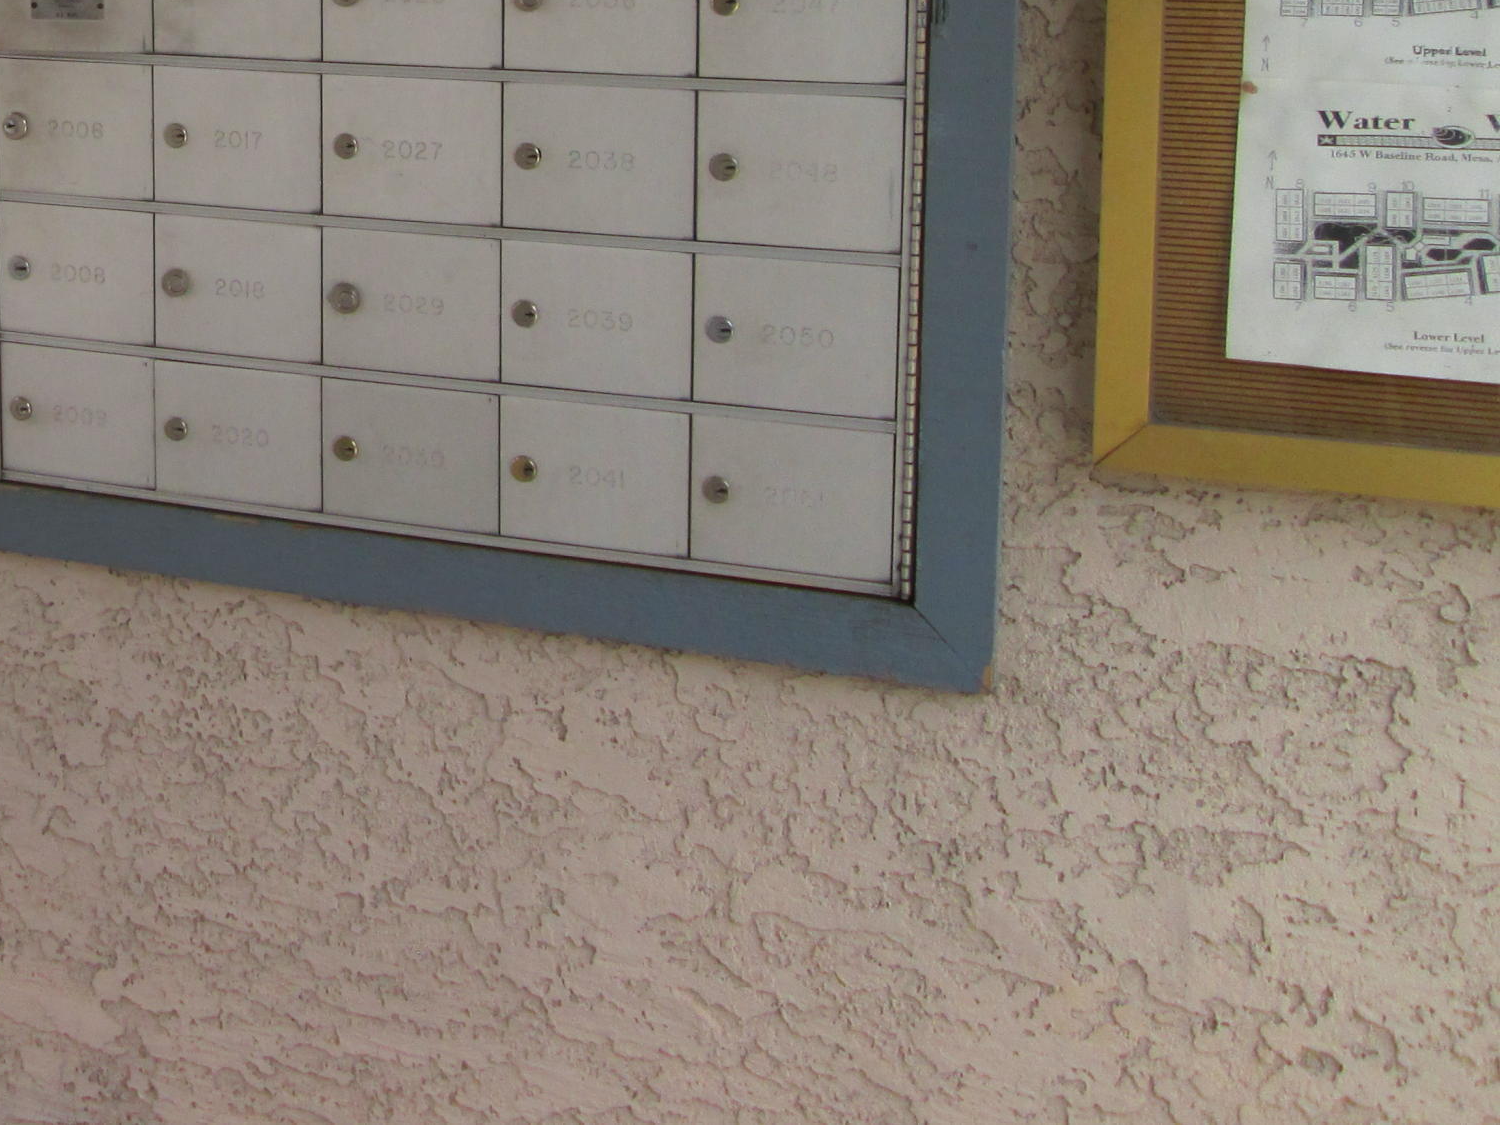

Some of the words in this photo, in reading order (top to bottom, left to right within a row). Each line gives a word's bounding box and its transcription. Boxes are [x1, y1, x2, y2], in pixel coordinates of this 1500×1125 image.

[1354, 18, 1364, 28] 6
[1392, 18, 1401, 28] 5
[1412, 45, 1451, 58] Upper
[1455, 46, 1487, 57] Level
[1317, 110, 1416, 131] Water
[214, 130, 262, 150] 2017
[382, 140, 442, 160] 2027
[568, 150, 635, 171] 2038
[1330, 150, 1357, 159] 1645
[1360, 150, 1371, 159] W
[1375, 151, 1422, 162] Baseline
[1425, 152, 1458, 163] Road,
[1402, 180, 1415, 191] 10
[215, 278, 265, 299] 2018
[383, 292, 444, 315] 2029
[1348, 301, 1357, 312] 6
[1386, 302, 1396, 313] 5
[567, 308, 633, 331] 2039
[761, 323, 834, 347] 2050
[1413, 330, 1450, 342] Lower
[1454, 332, 1485, 343] Level
[1405, 344, 1437, 353] reverse
[212, 424, 268, 448] 2020
[570, 465, 625, 490] 2041
